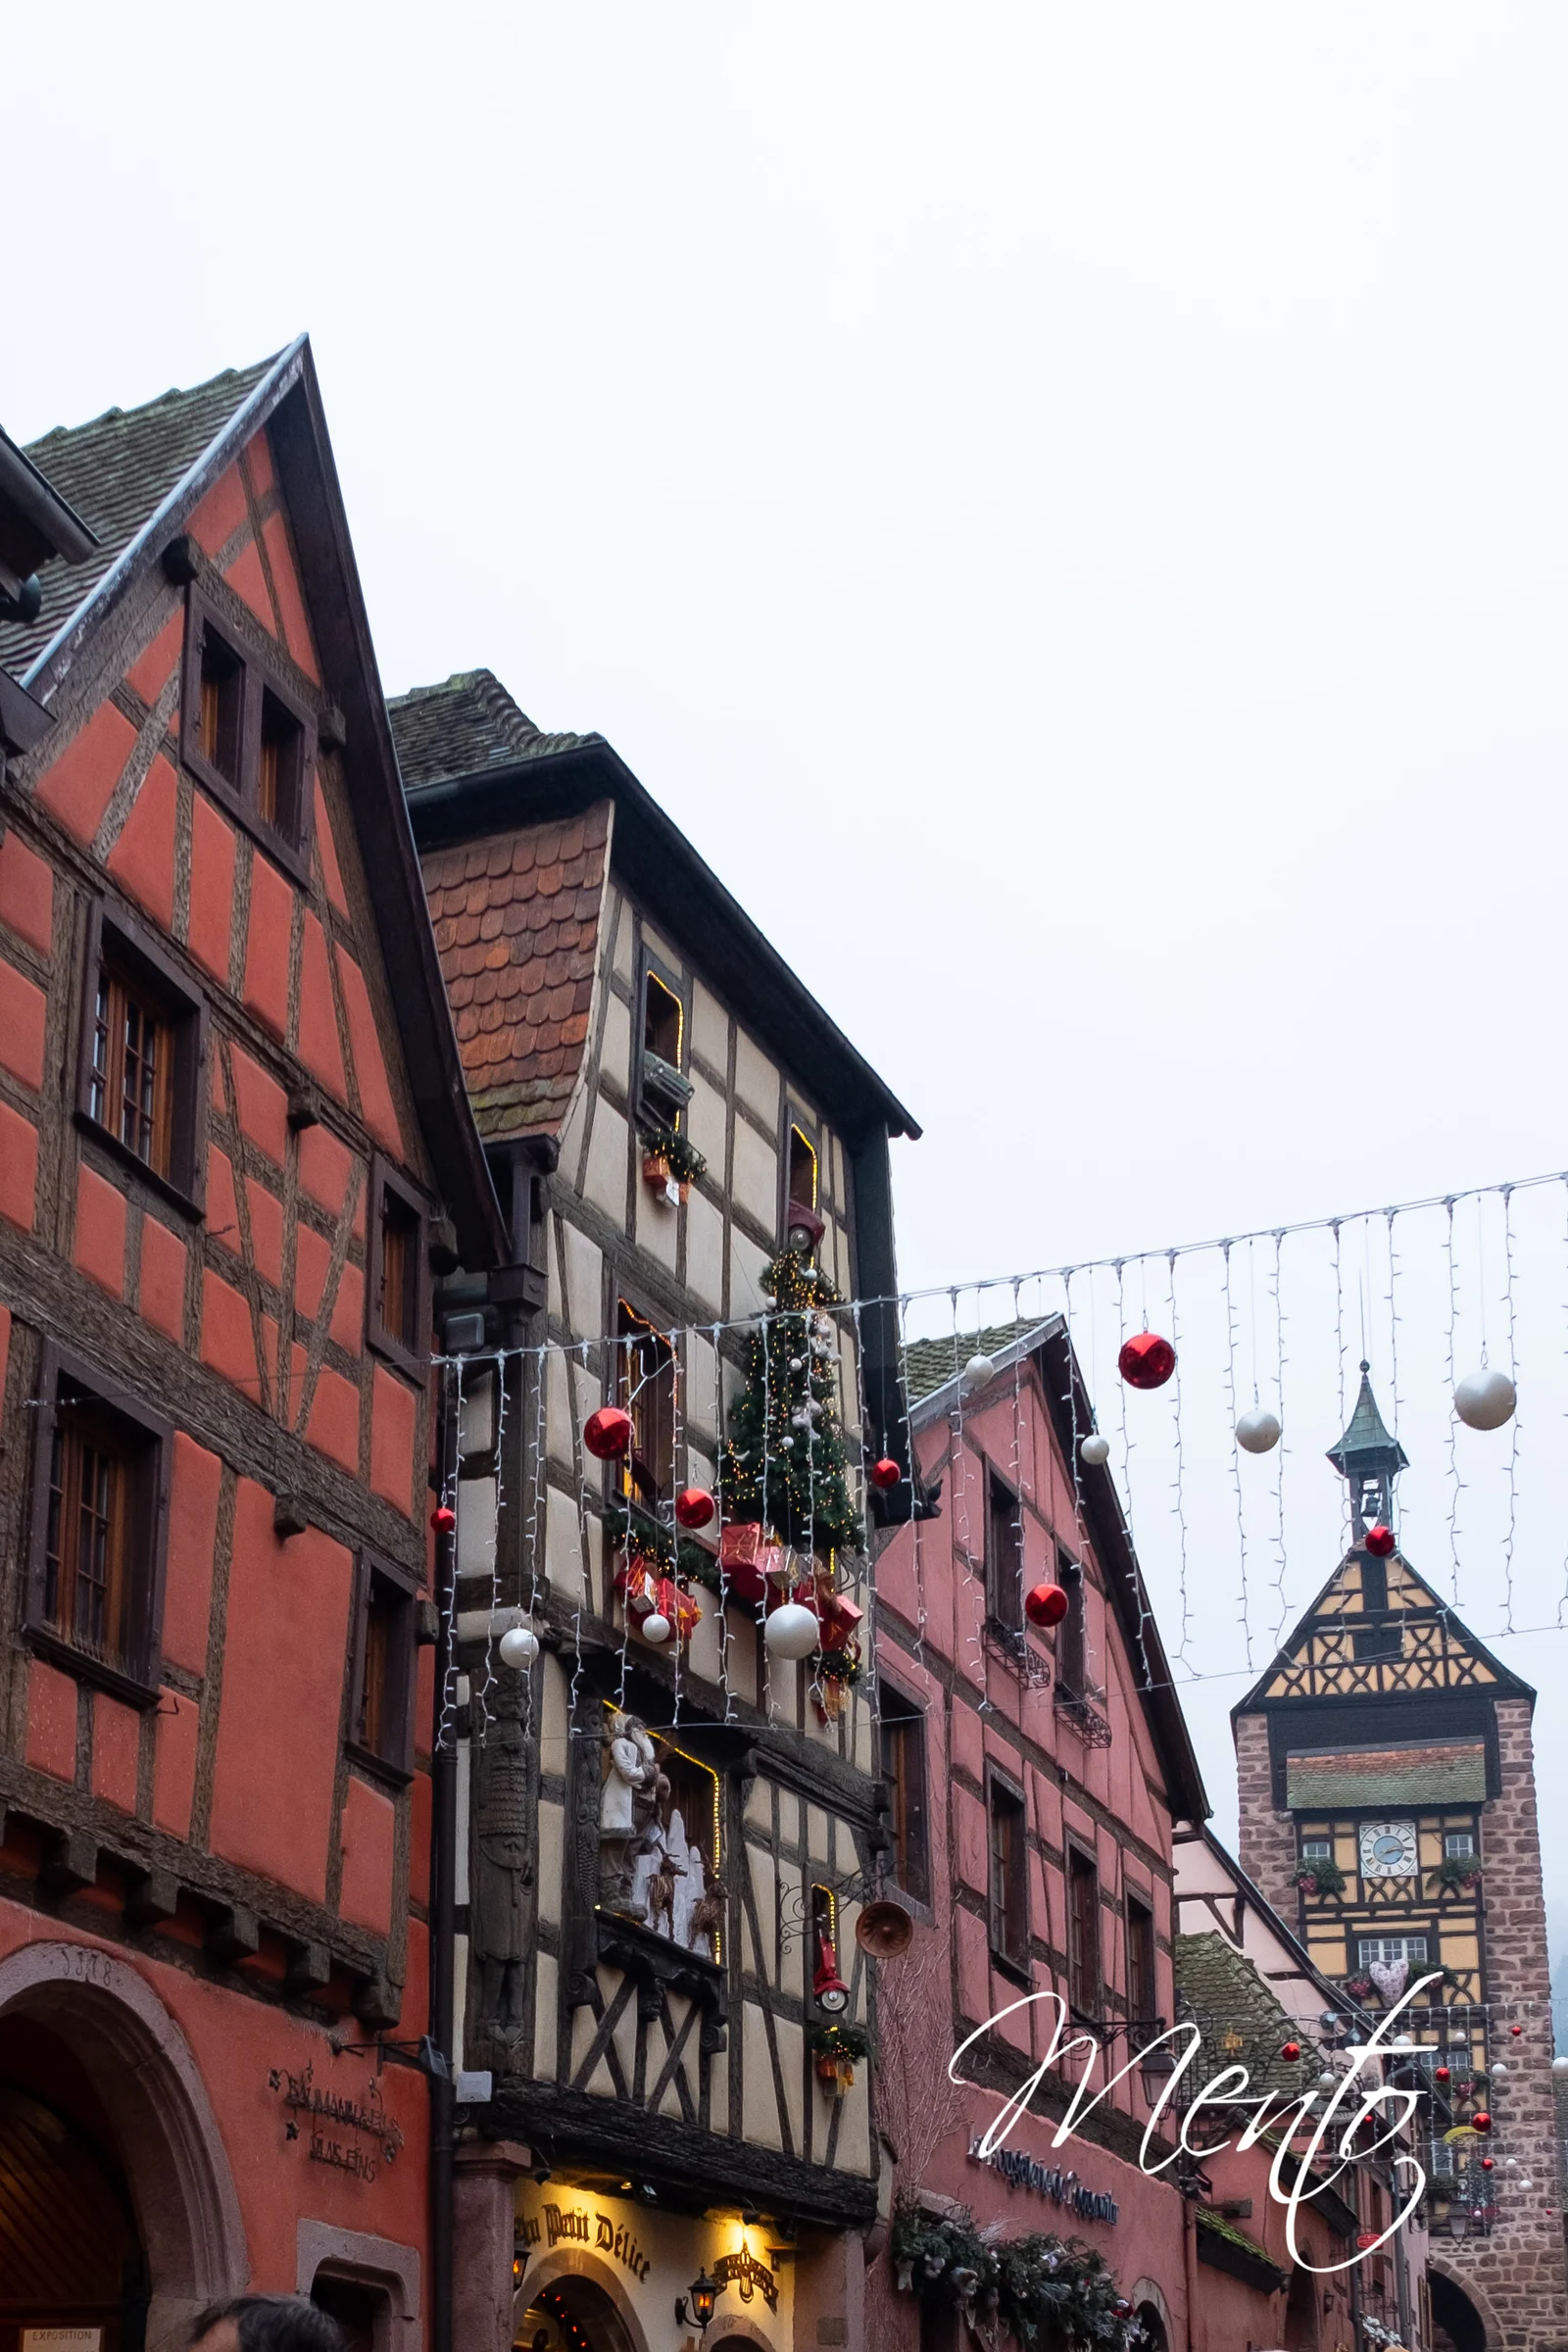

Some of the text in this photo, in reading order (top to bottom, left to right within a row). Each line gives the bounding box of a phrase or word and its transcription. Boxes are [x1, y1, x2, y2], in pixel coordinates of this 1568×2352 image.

[541, 2202, 590, 2248] Petit
[594, 2211, 652, 2285] Délice
[31, 2330, 93, 2341] EXPOSITION
